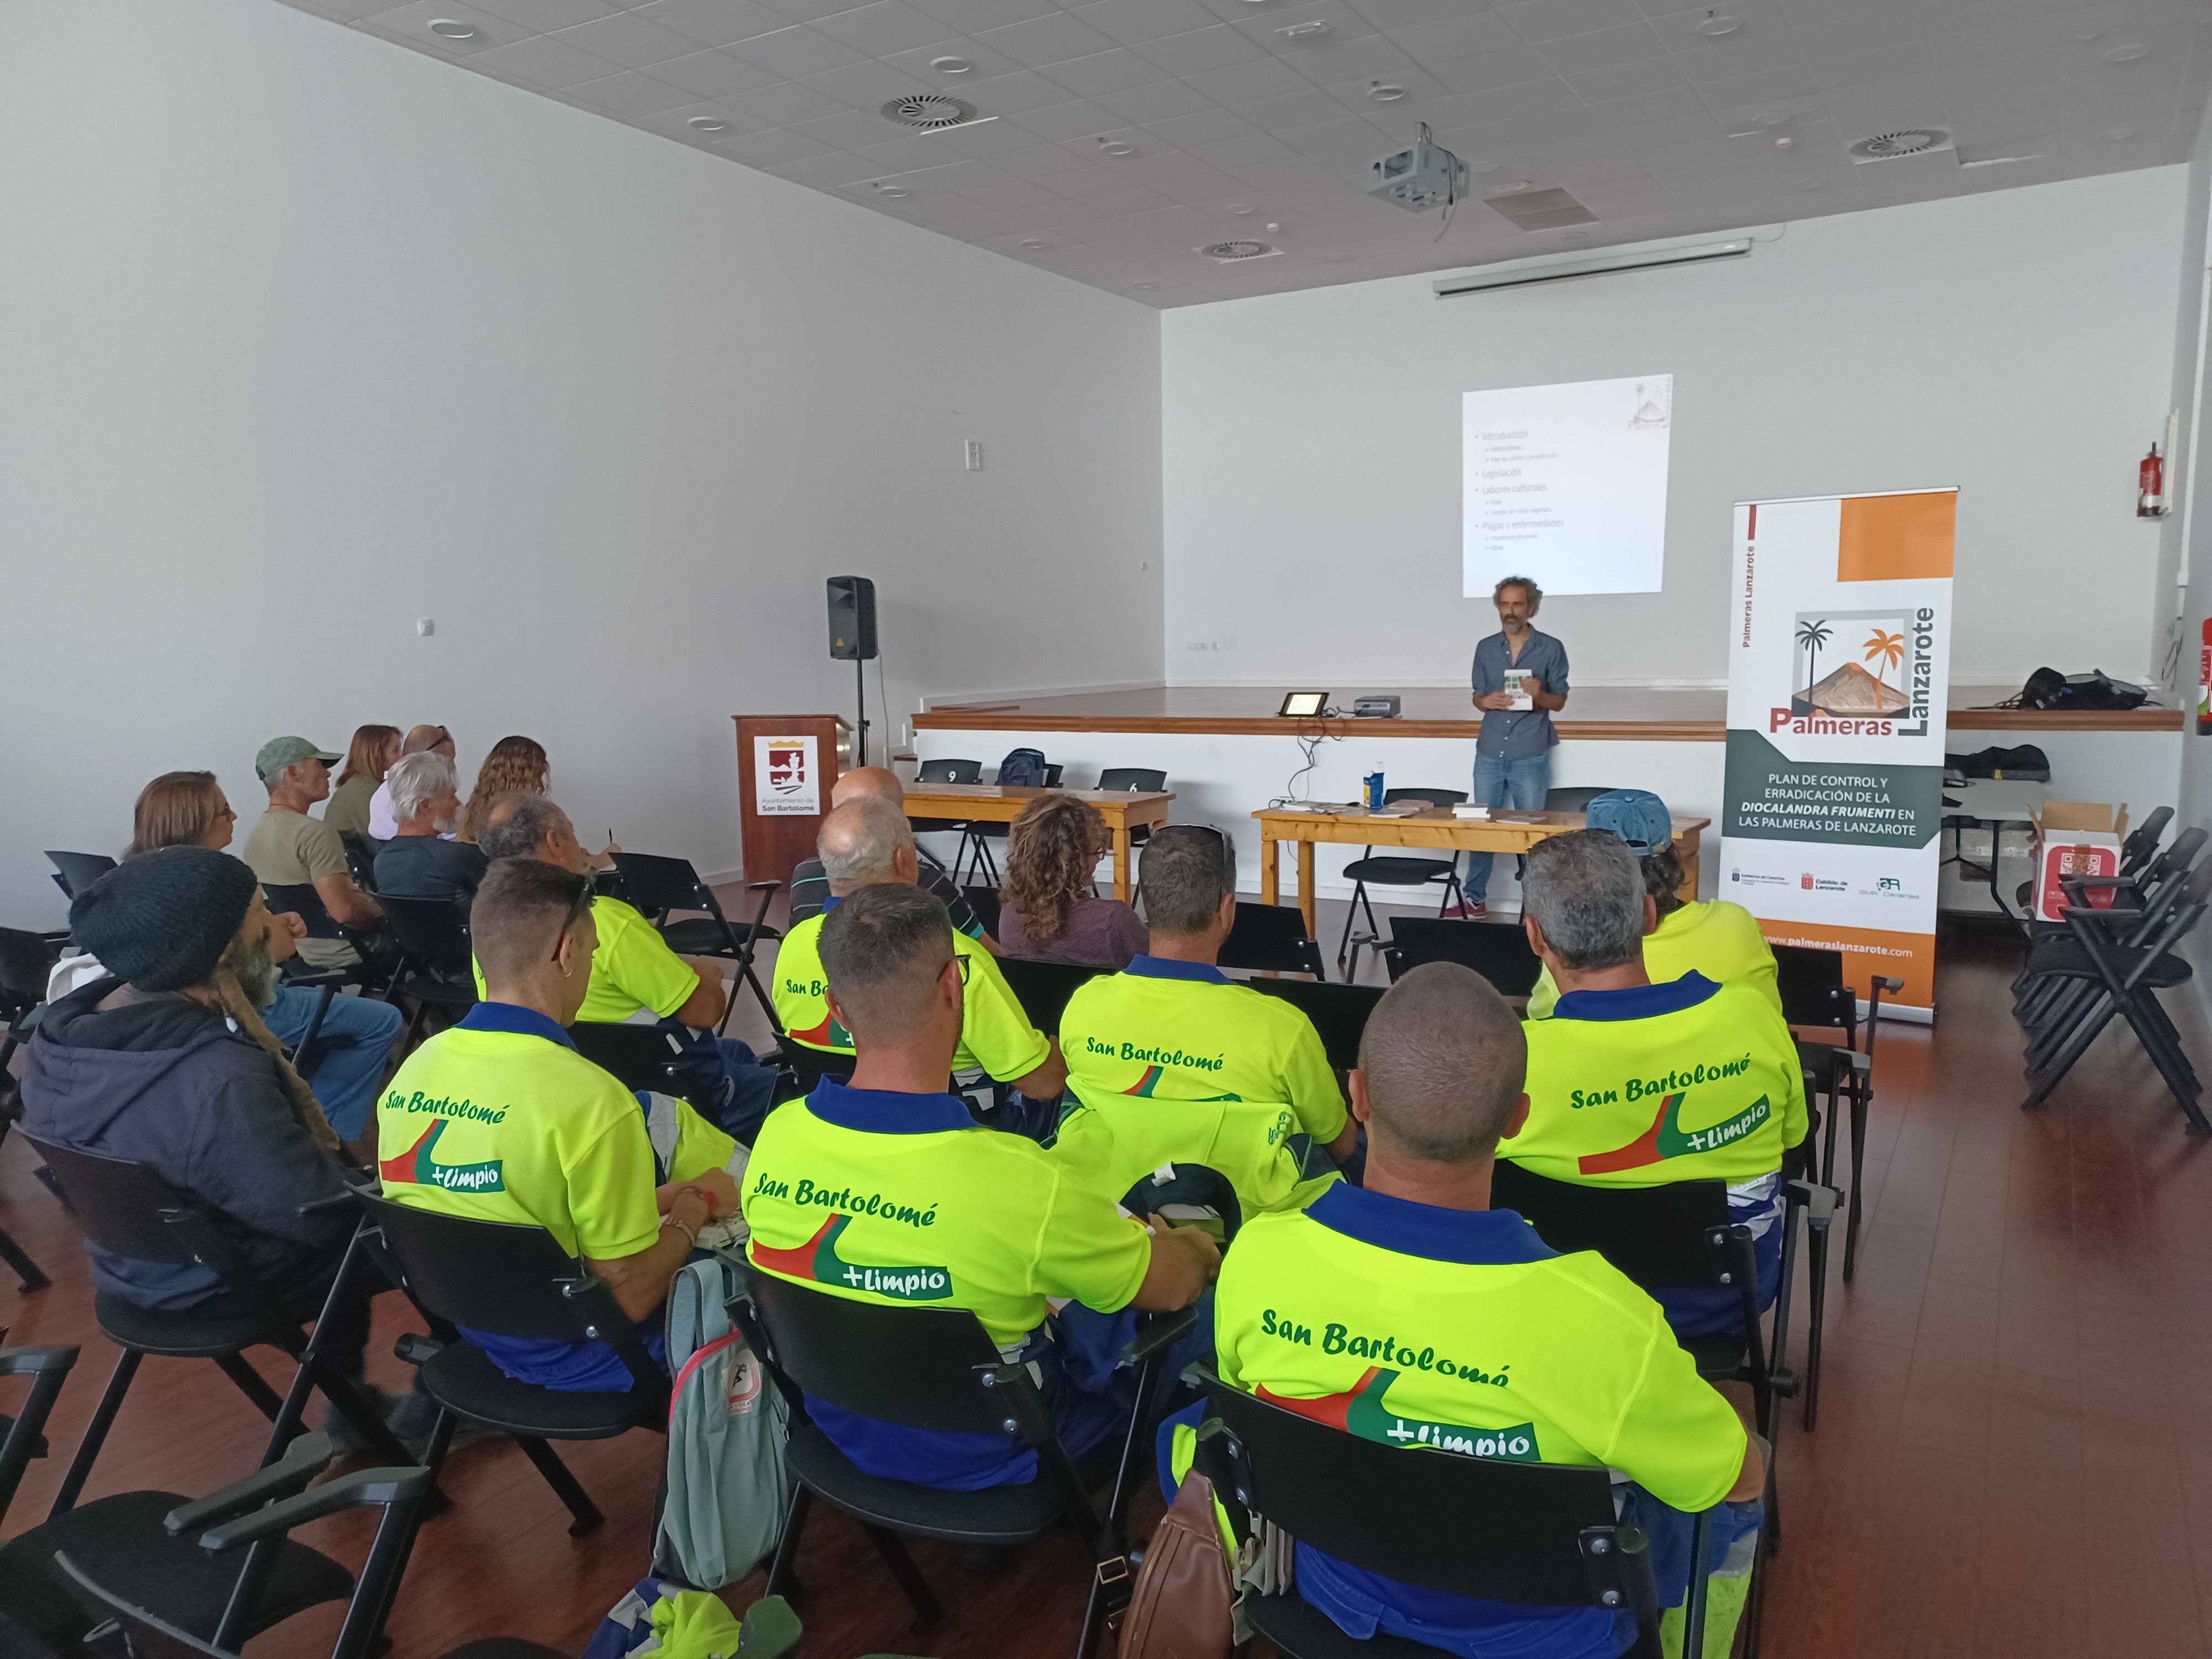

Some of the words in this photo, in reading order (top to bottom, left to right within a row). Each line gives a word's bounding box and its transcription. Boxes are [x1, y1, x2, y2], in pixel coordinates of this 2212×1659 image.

[1745, 546, 1755, 598] Lanzarote
[1743, 601, 1752, 648] Palmeras
[1897, 608, 1934, 737] Lanzarote
[1770, 707, 1892, 735] Palmeras
[948, 770, 957, 782] 9
[1768, 774, 1799, 785] PLAN
[1802, 775, 1817, 786] DE
[1820, 775, 1877, 788] CONTROL
[1880, 778, 1888, 788] Y
[1741, 802, 1828, 816] DIOCALANDRA
[1831, 806, 1896, 819] FRUMENTI
[1898, 810, 1914, 820] EN
[1765, 788, 1853, 802] ERRADICACIÓN
[1856, 792, 1872, 803] DE
[1875, 793, 1890, 804] LA
[1739, 816, 1759, 827] LAS
[1762, 817, 1822, 831] PALMERAS
[1825, 821, 1841, 831] DE
[1844, 822, 1916, 836] LANZAROTE
[786, 979, 806, 994] San
[1087, 1037, 1115, 1056] San
[1120, 1042, 1224, 1072] Bartolomé
[1571, 1089, 1618, 1109] San
[1625, 1052, 1751, 1102] Bartolomé
[386, 1091, 405, 1109] San
[408, 1091, 510, 1125] Bartolomé
[754, 1172, 789, 1199] San
[795, 1178, 939, 1228] Bartolomé
[1261, 1309, 1312, 1345] San
[1322, 1323, 1511, 1389] Bartolomé
